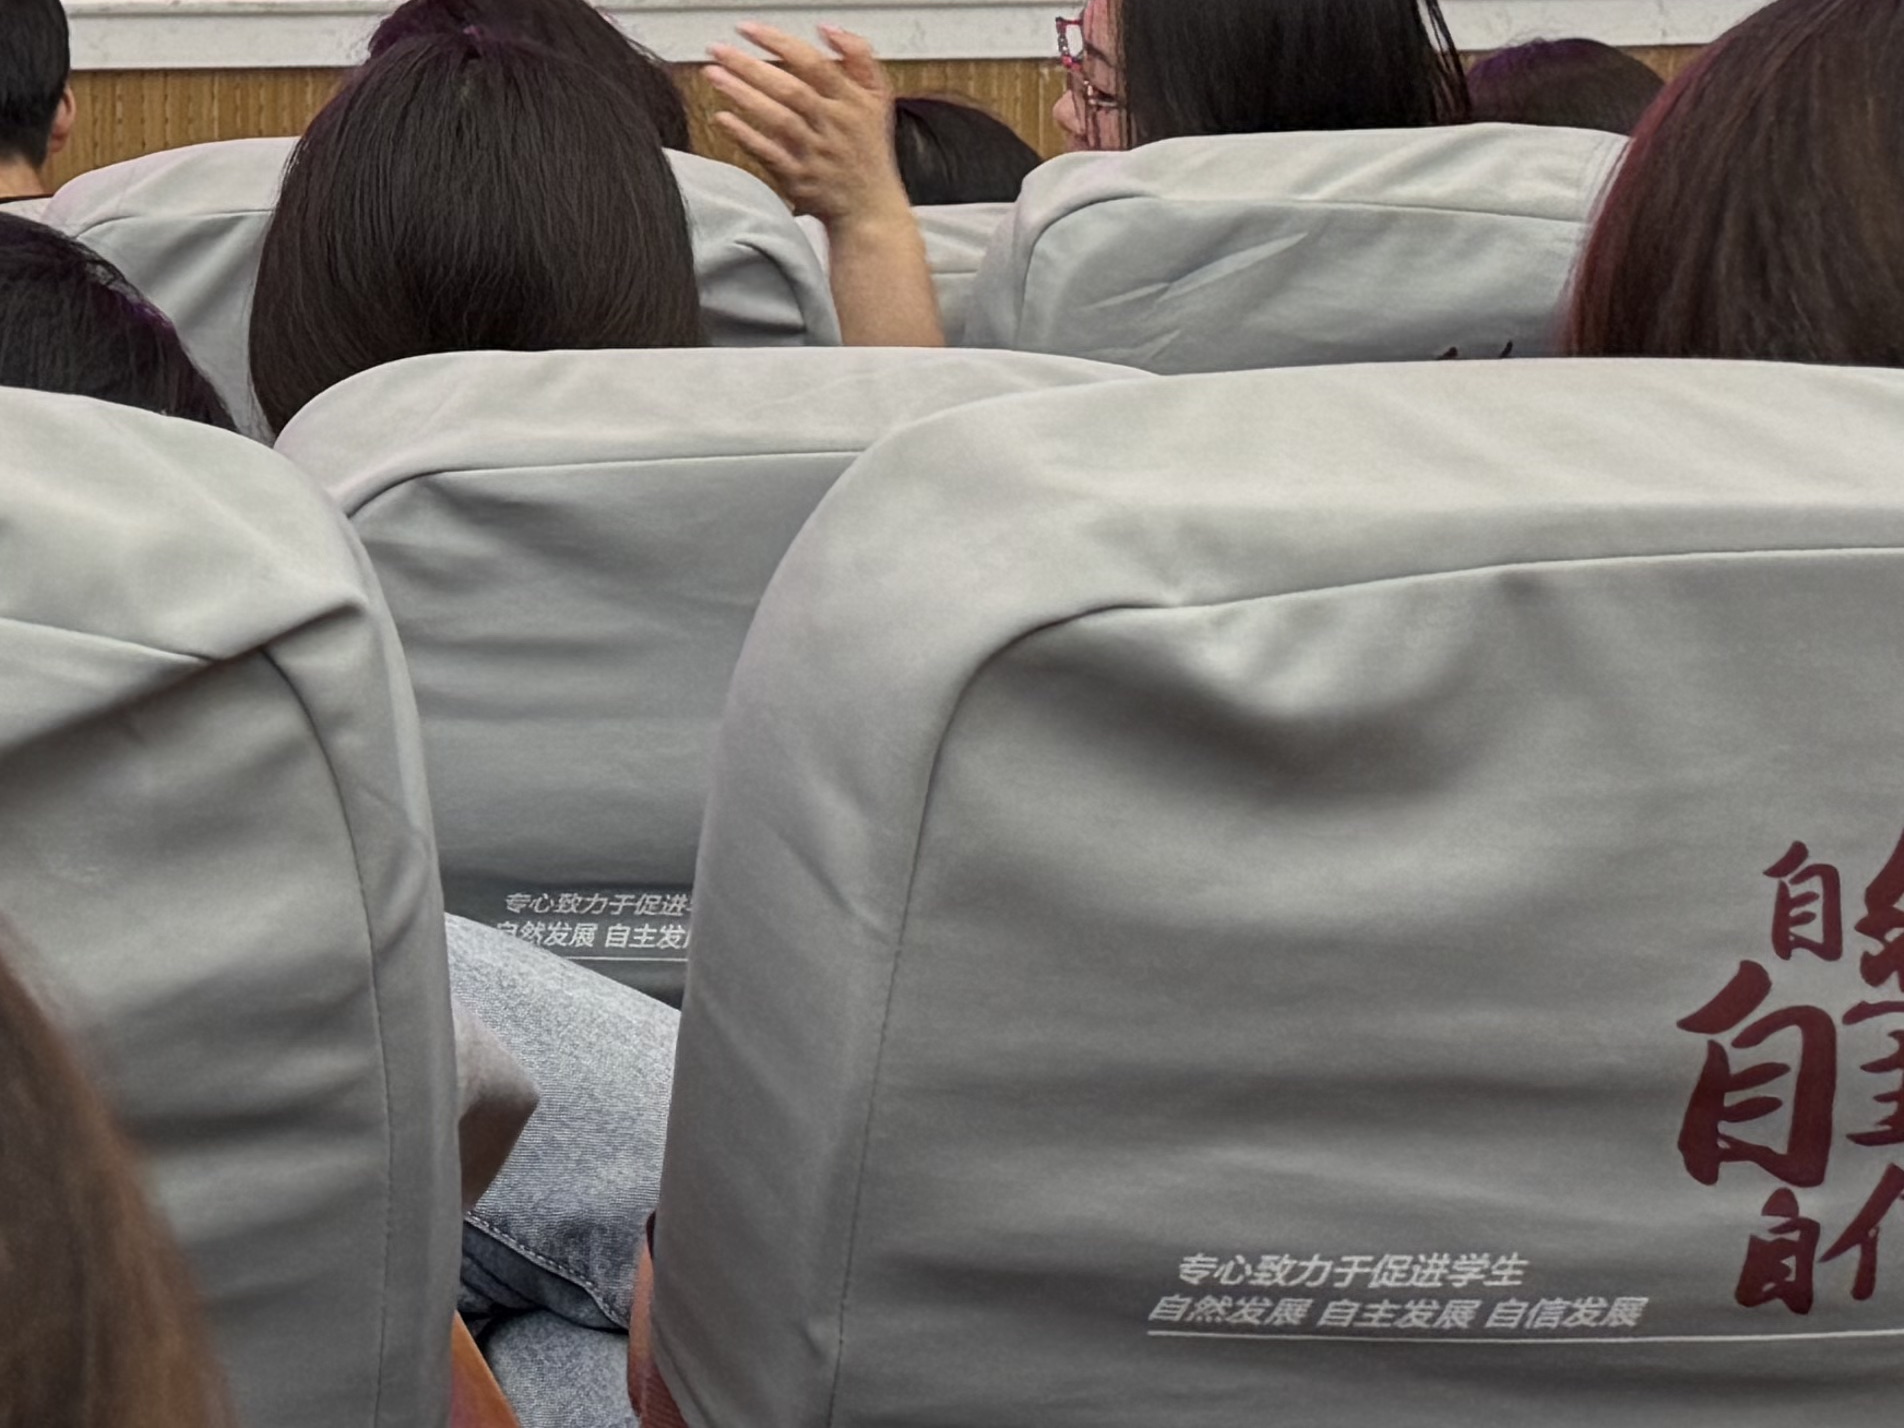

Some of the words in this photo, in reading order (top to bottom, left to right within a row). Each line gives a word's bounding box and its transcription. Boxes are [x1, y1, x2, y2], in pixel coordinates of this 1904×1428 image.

[505, 892, 693, 917] 专心致力于促进
[604, 922, 691, 950] 自主发
[1178, 1252, 1529, 1289] 专心致力于促进学生
[1148, 1293, 1314, 1325] 自然发展
[1317, 1298, 1480, 1330] 自主发展
[1484, 1296, 1649, 1330] 自信发展
